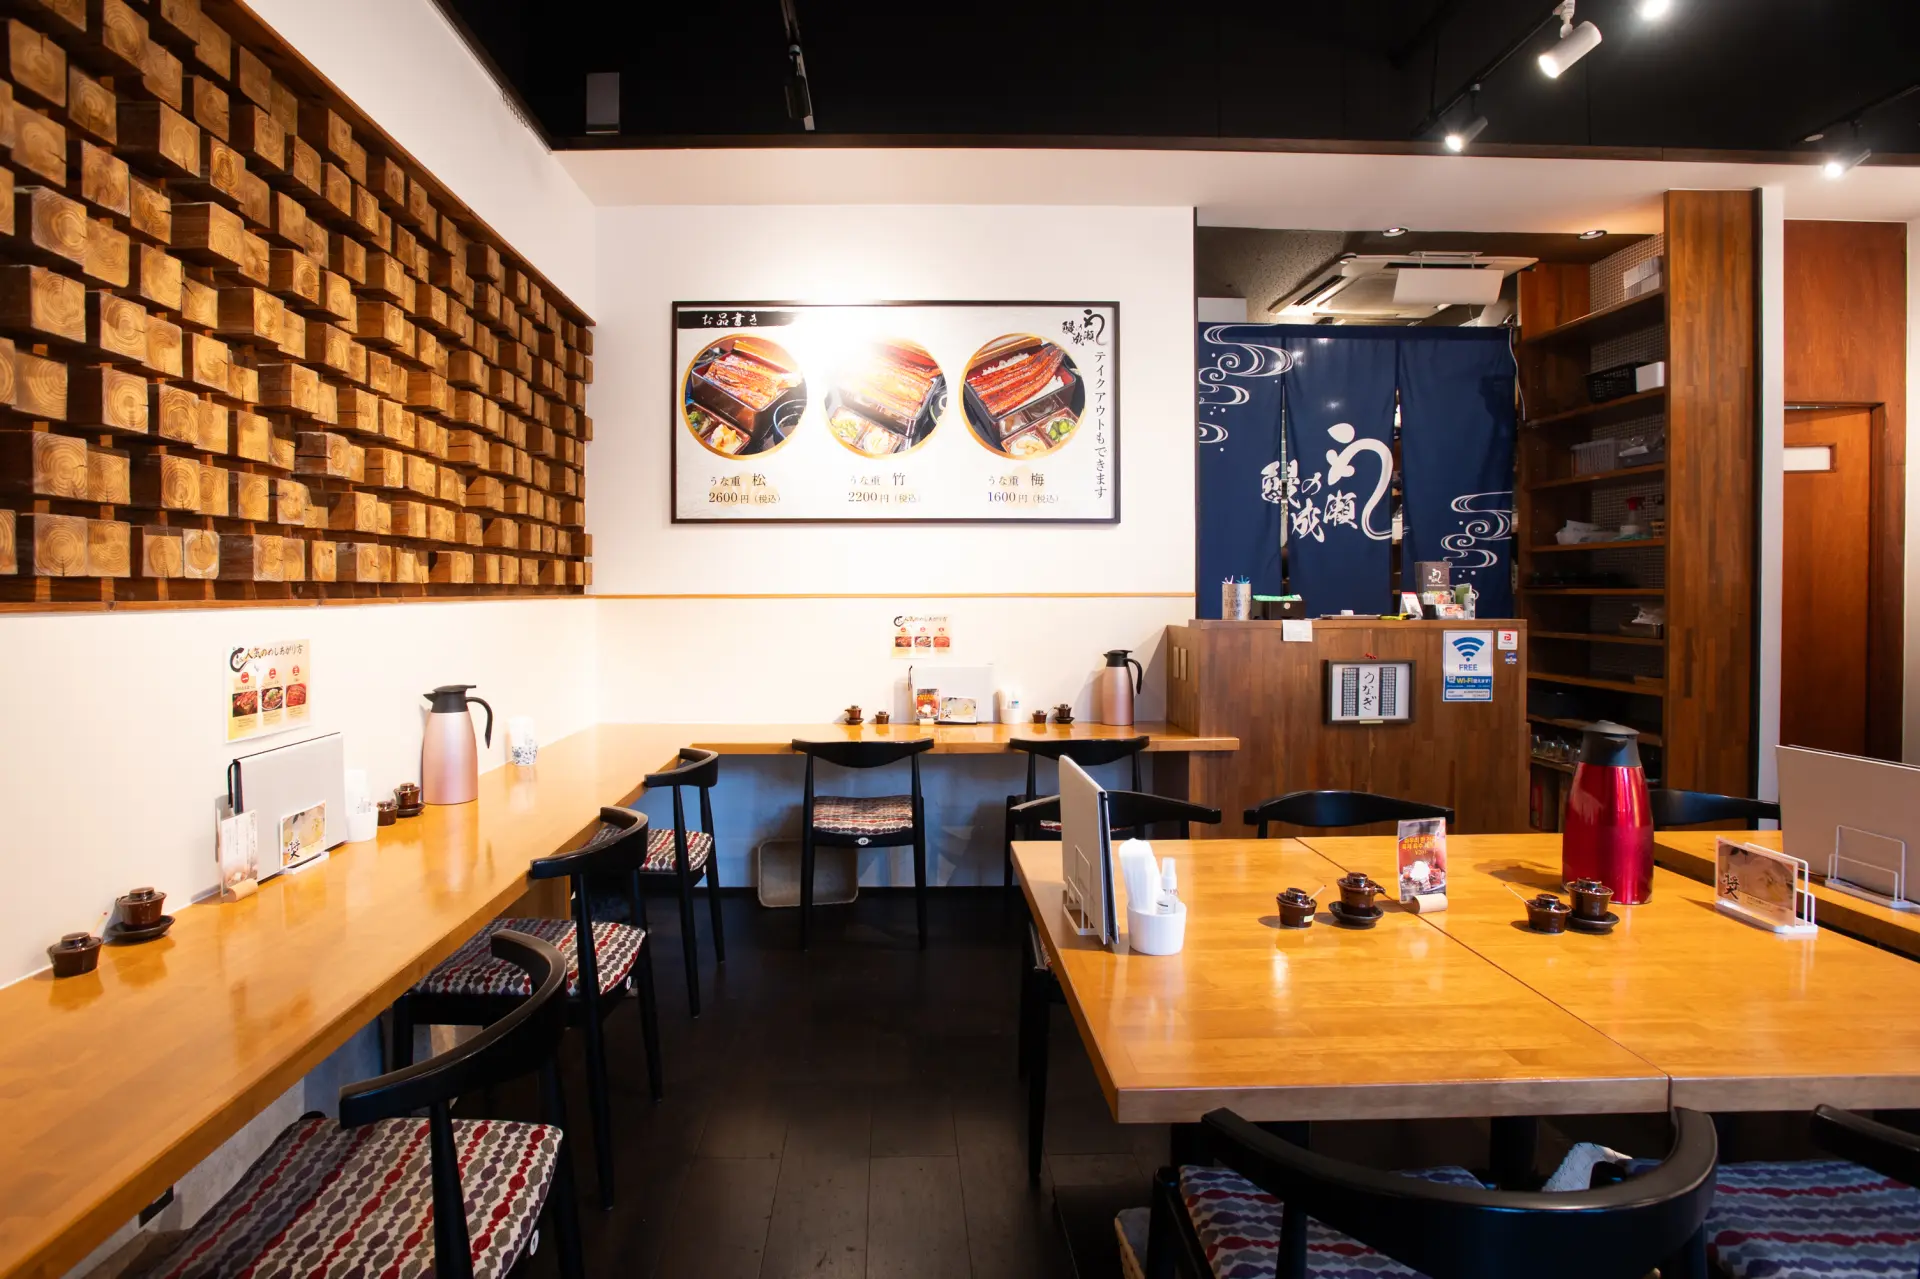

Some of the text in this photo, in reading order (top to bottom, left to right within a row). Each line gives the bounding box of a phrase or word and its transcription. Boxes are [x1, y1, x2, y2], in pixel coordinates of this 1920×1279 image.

[701, 312, 758, 327] お品書き
[1094, 351, 1107, 499] テイクアウトもできます
[710, 473, 766, 486] うな重 松
[850, 472, 906, 486] うな重 竹
[988, 472, 1045, 486] うな重 梅
[1458, 663, 1478, 671] FREE
[1362, 671, 1377, 711] うなぎ
